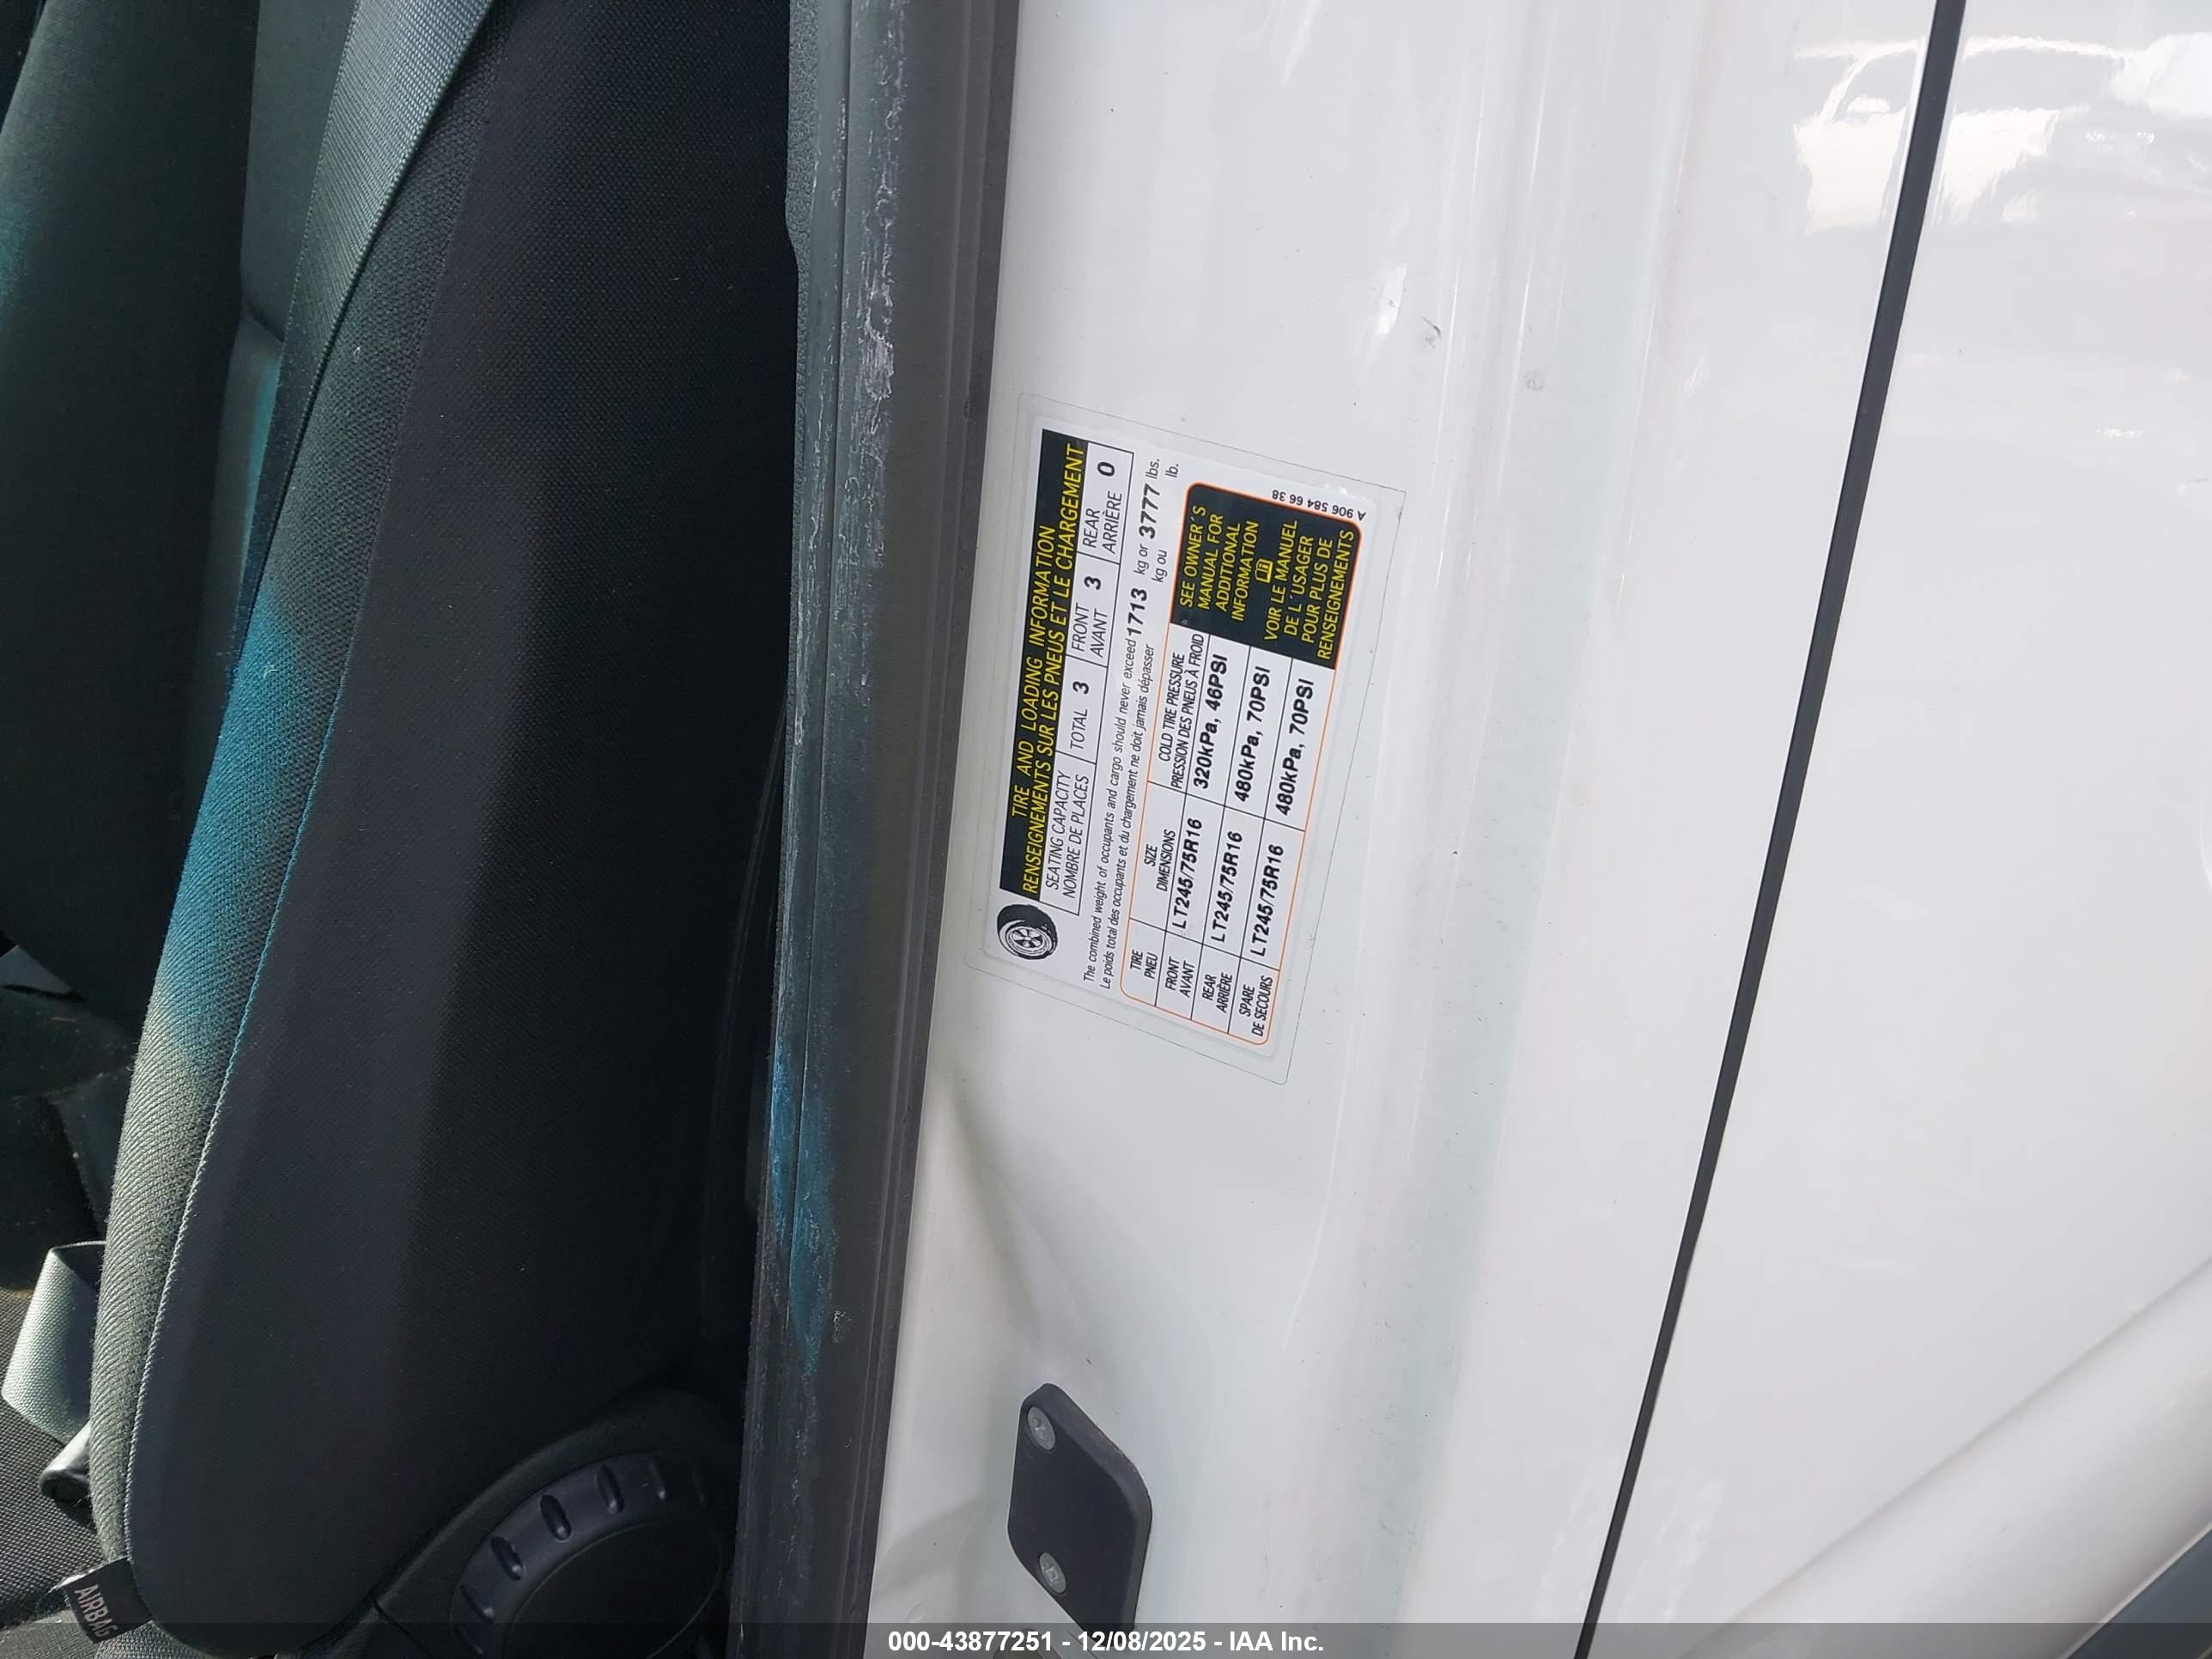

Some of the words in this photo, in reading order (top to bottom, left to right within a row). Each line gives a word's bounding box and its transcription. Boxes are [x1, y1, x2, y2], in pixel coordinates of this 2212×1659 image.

[1096, 461, 1115, 477] 0
[1145, 459, 1160, 480] lbs.
[1164, 464, 1180, 478] lb.
[1054, 442, 1085, 570] CHARGEMENT
[1138, 483, 1161, 540] 3777
[1272, 489, 1286, 502] 38
[1288, 494, 1304, 507] 66
[1306, 498, 1329, 513] 584
[1331, 504, 1354, 520] 906
[1082, 507, 1101, 549] REAR
[1101, 490, 1122, 555] ARRIÈRE
[1206, 514, 1224, 544] FOR
[1357, 510, 1367, 521] A
[1138, 543, 1149, 557] or
[1157, 549, 1168, 565] ou
[1273, 520, 1298, 582] MANUEL
[1316, 537, 1334, 559] DE
[1083, 575, 1102, 591] 3
[1133, 559, 1150, 575] kg
[1151, 567, 1168, 583] kg
[1197, 548, 1219, 610] MANUAL
[1215, 522, 1241, 612] ADDITIONAL
[1231, 520, 1260, 622] INFORMATION
[1309, 562, 1328, 601] PLUS
[1028, 525, 1056, 647] INFORMATION
[1052, 574, 1071, 599] LE
[1179, 580, 1196, 608] SEE
[1270, 584, 1286, 605] LE
[1316, 529, 1355, 660] RENSEIGNEMENTS
[1049, 600, 1068, 626] ET
[1071, 601, 1090, 652] FRONT
[1126, 587, 1148, 637] 1713
[1263, 606, 1283, 640] VOIR
[1283, 615, 1300, 636] DE
[1301, 604, 1322, 644] POUR
[1089, 607, 1109, 659] AVANT
[1188, 633, 1205, 667] FROID
[1043, 629, 1066, 686] PNEUS
[1123, 637, 1137, 679] exceed
[1137, 643, 1155, 694] dépasser
[1183, 669, 1200, 679] À
[1020, 656, 1043, 732] LOADING
[1072, 680, 1090, 695] 3
[1165, 652, 1186, 707] PRESSURE
[1181, 678, 1198, 716] PNEUS
[1204, 653, 1228, 712] 46PSI
[1246, 665, 1271, 723] 70PSI
[1040, 688, 1060, 721] LES
[1119, 682, 1131, 714] never
[1133, 695, 1148, 732] jamais
[1288, 678, 1315, 736] 70PSI
[1069, 708, 1088, 750] TOTAL
[1111, 716, 1127, 754] should
[1162, 707, 1177, 730] TIRE
[1177, 715, 1193, 739] DES
[1036, 724, 1055, 757] SUR
[1129, 730, 1144, 752] doit
[1158, 732, 1174, 763] COLD
[1193, 718, 1222, 790] 320kPa,
[1016, 740, 1035, 777] AND
[1109, 756, 1124, 787] cargo
[1130, 754, 1140, 769] ne
[1170, 738, 1189, 790] PRESSION
[1233, 730, 1264, 803] 480kPa,
[1274, 743, 1306, 817] 480kPa,
[1011, 784, 1030, 817] TIRE
[1051, 769, 1072, 835] CAPACITY
[1070, 774, 1090, 825] PLACES
[1105, 787, 1118, 810] and
[1120, 769, 1139, 829] chargement
[1022, 759, 1052, 894] RENSEIGNEMENTS
[1067, 825, 1084, 845] DE
[1100, 811, 1115, 864] occupants
[1117, 830, 1130, 844] du
[1045, 836, 1064, 890] SEATING
[1117, 844, 1128, 857] et
[1143, 843, 1158, 867] SIZE
[1155, 829, 1176, 892] DIMENSIONS
[1061, 845, 1081, 899] NOMBRE
[1096, 865, 1108, 878] of
[1112, 858, 1127, 908] occupants
[1171, 817, 1203, 930] LT245/75R16
[1210, 830, 1243, 944] LT245/75R16
[1093, 880, 1108, 914] weight
[1249, 843, 1285, 957] LT245/75R16
[1107, 908, 1121, 927] des
[1087, 915, 1103, 963] combined
[1105, 926, 1118, 950] total
[1083, 964, 1097, 982] The
[1102, 951, 1115, 977] poids
[1129, 948, 1144, 970] TIRE
[1143, 951, 1158, 980] PNEU
[1164, 956, 1181, 992] FRONT
[1099, 976, 1112, 990] Le
[1178, 959, 1195, 999] AVANT
[1201, 974, 1218, 1001] REAR
[1215, 971, 1233, 1014] ARRIÈRE
[1238, 983, 1255, 1018] SPARE
[1254, 975, 1273, 1022] SECOURS
[1250, 1020, 1266, 1037] DE
[74, 1584, 118, 1637] AIRBAG
